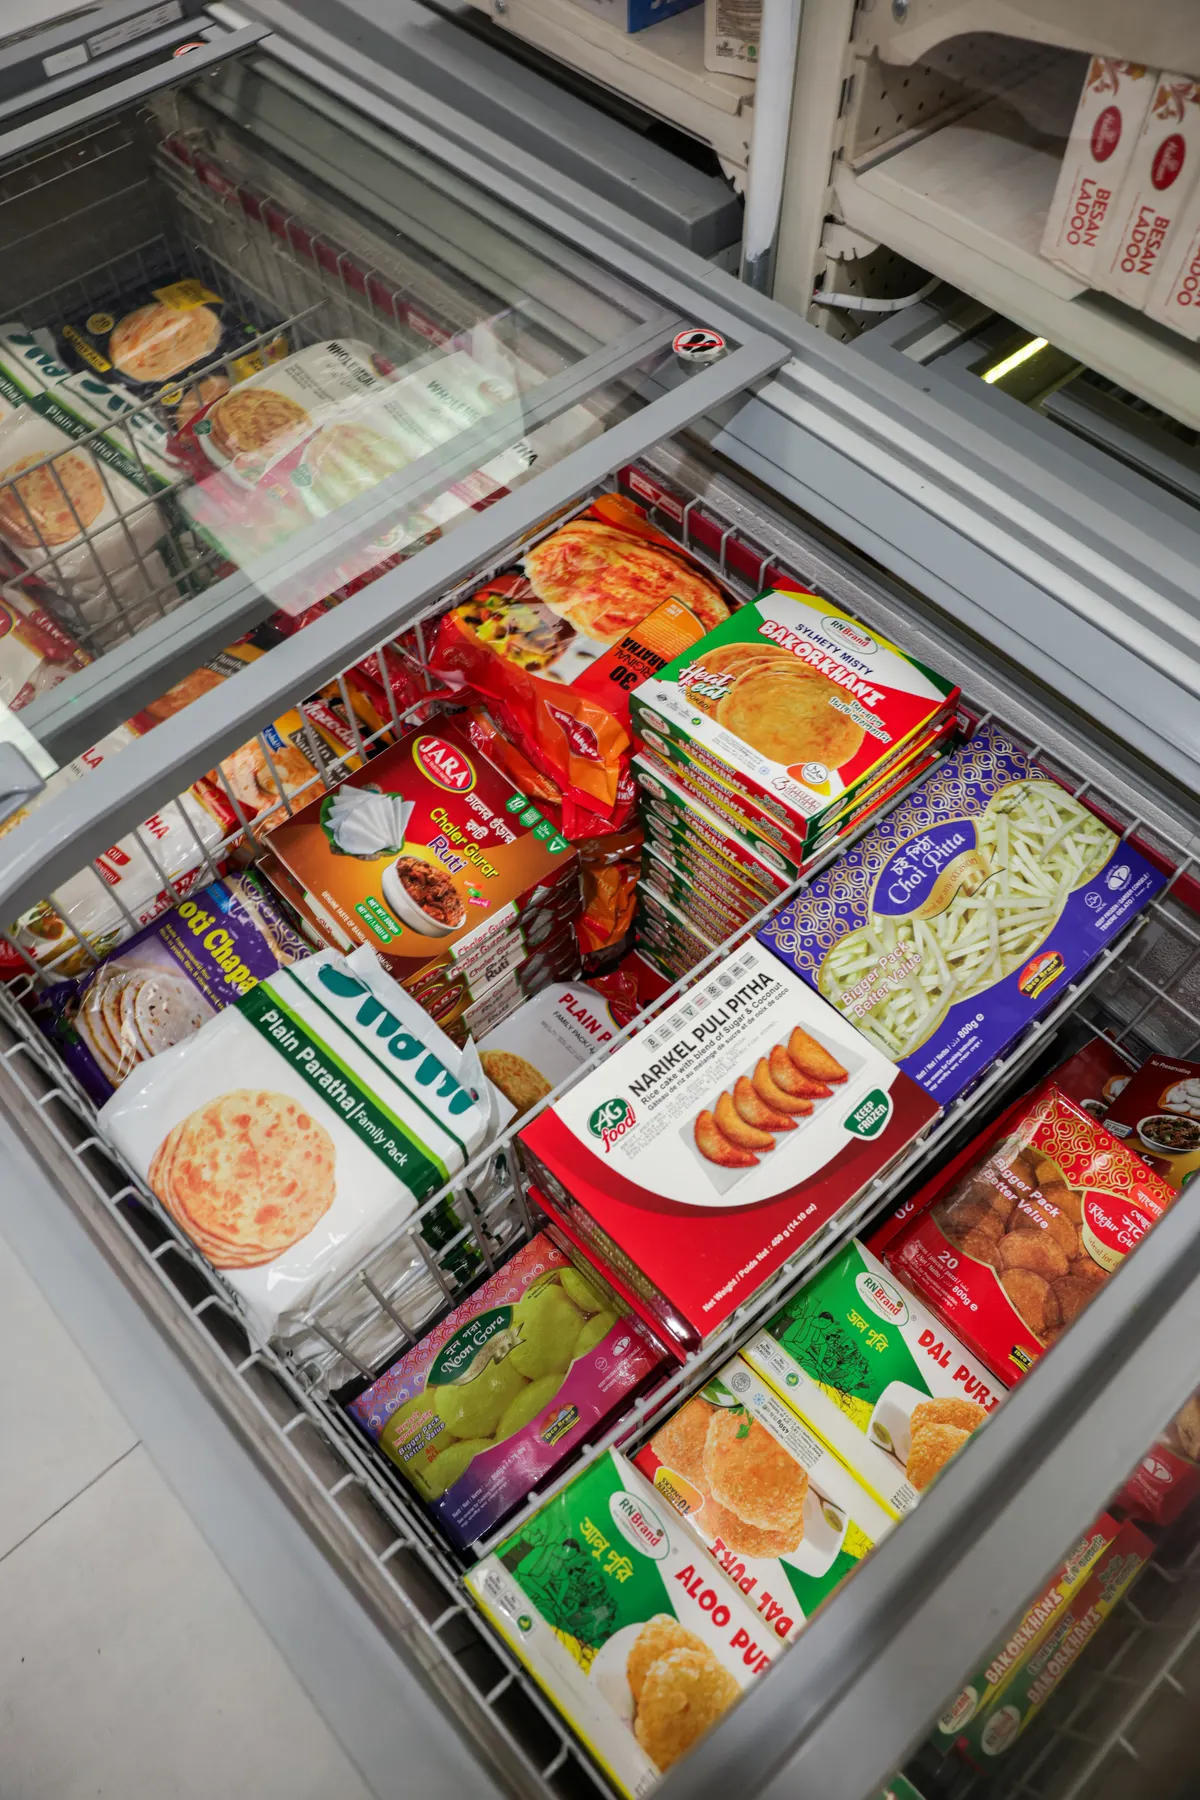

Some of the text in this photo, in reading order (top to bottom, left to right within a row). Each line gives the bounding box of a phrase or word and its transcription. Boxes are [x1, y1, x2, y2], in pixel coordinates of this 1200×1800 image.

[1065, 177, 1096, 245] LADOO
[1081, 187, 1110, 247] BESAN
[1119, 205, 1155, 274] LADOO
[1136, 216, 1170, 275] BESAN
[45, 402, 76, 431] Plain
[757, 618, 885, 709] BAKORKHANI
[794, 622, 873, 677] SYLHETY MISTY
[608, 664, 638, 691] 30
[677, 661, 737, 691] Heat
[689, 677, 732, 703] eat
[677, 686, 710, 712] (COOKED)
[418, 734, 470, 788] JARA
[462, 790, 495, 822] চালের
[510, 794, 525, 809] 10
[426, 831, 467, 876] Ruti
[428, 804, 499, 880] Chaler Gurar
[902, 830, 937, 864] পিঠা
[883, 829, 973, 908] Choi Pitta
[947, 855, 978, 883] occasion
[320, 889, 355, 927] GENUINE TASTE OF
[356, 904, 366, 915] NET
[367, 898, 378, 910] NET
[1094, 903, 1118, 927] KEEP FROZEN
[174, 936, 187, 948] from
[449, 931, 507, 977] Chaler Gurar
[456, 909, 517, 957] Chaler Gurar
[466, 932, 523, 977] Chaler Gurar
[483, 957, 511, 982] Ruti
[840, 937, 910, 1007] Bigger Pack
[853, 951, 923, 1019] Better Value
[1024, 958, 1058, 992] Ibco Brand
[552, 1010, 574, 1031] FAMILY
[557, 991, 602, 1035] PLAIN
[627, 1035, 697, 1097] NARIKEL
[692, 1004, 733, 1042] PULI
[725, 969, 774, 1013] PITHA
[639, 980, 784, 1106] Rice cake with blend of Sugar & Coconut
[646, 1037, 655, 1046] 8
[667, 1083, 678, 1093] de
[676, 1075, 686, 1085] riz
[683, 1069, 694, 1079] au
[715, 1041, 726, 1051] de
[723, 1028, 742, 1044] sucre
[739, 1021, 748, 1030] et
[746, 1015, 755, 1025] de
[753, 1004, 768, 1018] noix
[766, 998, 776, 1007] de
[772, 986, 789, 1001] coco
[914, 1018, 979, 1080] Nett Net Netto 800g
[258, 1008, 410, 1167] Plain Paratha Family Pack
[1159, 1062, 1191, 1075] Preservative
[589, 1099, 623, 1131] AG
[598, 1107, 636, 1152] food
[852, 1099, 876, 1122] KEEP
[856, 1103, 887, 1133] FROZEN
[983, 1168, 1050, 1230] Better Value
[993, 1156, 1060, 1218] Bigger Pack
[1086, 1201, 1119, 1235] Khejur
[701, 1201, 818, 1312] Net Weight Poids Net 400 g (14.10 oz)
[928, 1255, 945, 1270] pieces
[936, 1248, 960, 1270] 20
[1101, 1250, 1116, 1264] for
[862, 1275, 902, 1316] RNBrand
[917, 1255, 972, 1306] Net Netto 800g
[440, 1314, 505, 1374] Noon Gora
[844, 1307, 870, 1333] ডাল
[861, 1325, 892, 1356] পুরি
[917, 1328, 1001, 1414] DAL PURI
[394, 1421, 408, 1434] Very
[397, 1414, 441, 1456] Bigger Pack
[557, 1409, 575, 1426] Brand
[774, 1418, 791, 1435] 450g
[402, 1421, 446, 1462] Better Value
[660, 1476, 682, 1500] SNACKS
[617, 1496, 661, 1547] RNBrand
[569, 1515, 639, 1587] আলু পুরি
[674, 1562, 735, 1629] ALOO
[705, 1536, 798, 1639] DAL PURI
[982, 1586, 1065, 1685] BAKORKHANI
[1024, 1606, 1103, 1705] BAKORKHANI
